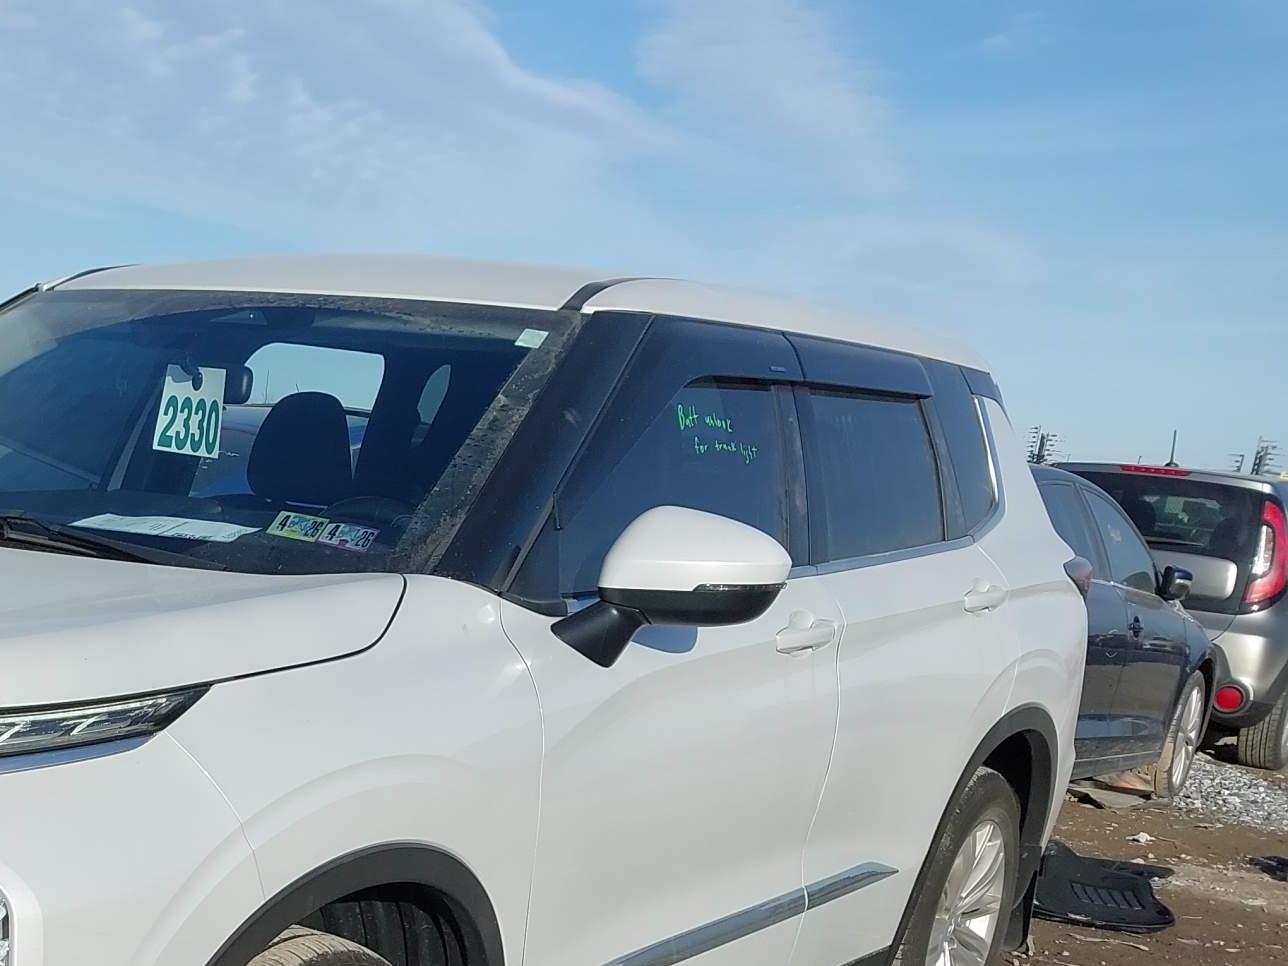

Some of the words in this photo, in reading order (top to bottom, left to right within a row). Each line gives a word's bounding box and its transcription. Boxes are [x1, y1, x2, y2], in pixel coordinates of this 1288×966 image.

[157, 395, 220, 455] 2330
[276, 514, 291, 532] 4
[304, 520, 325, 538] 26
[326, 524, 340, 541] 4
[355, 530, 375, 548] 26
